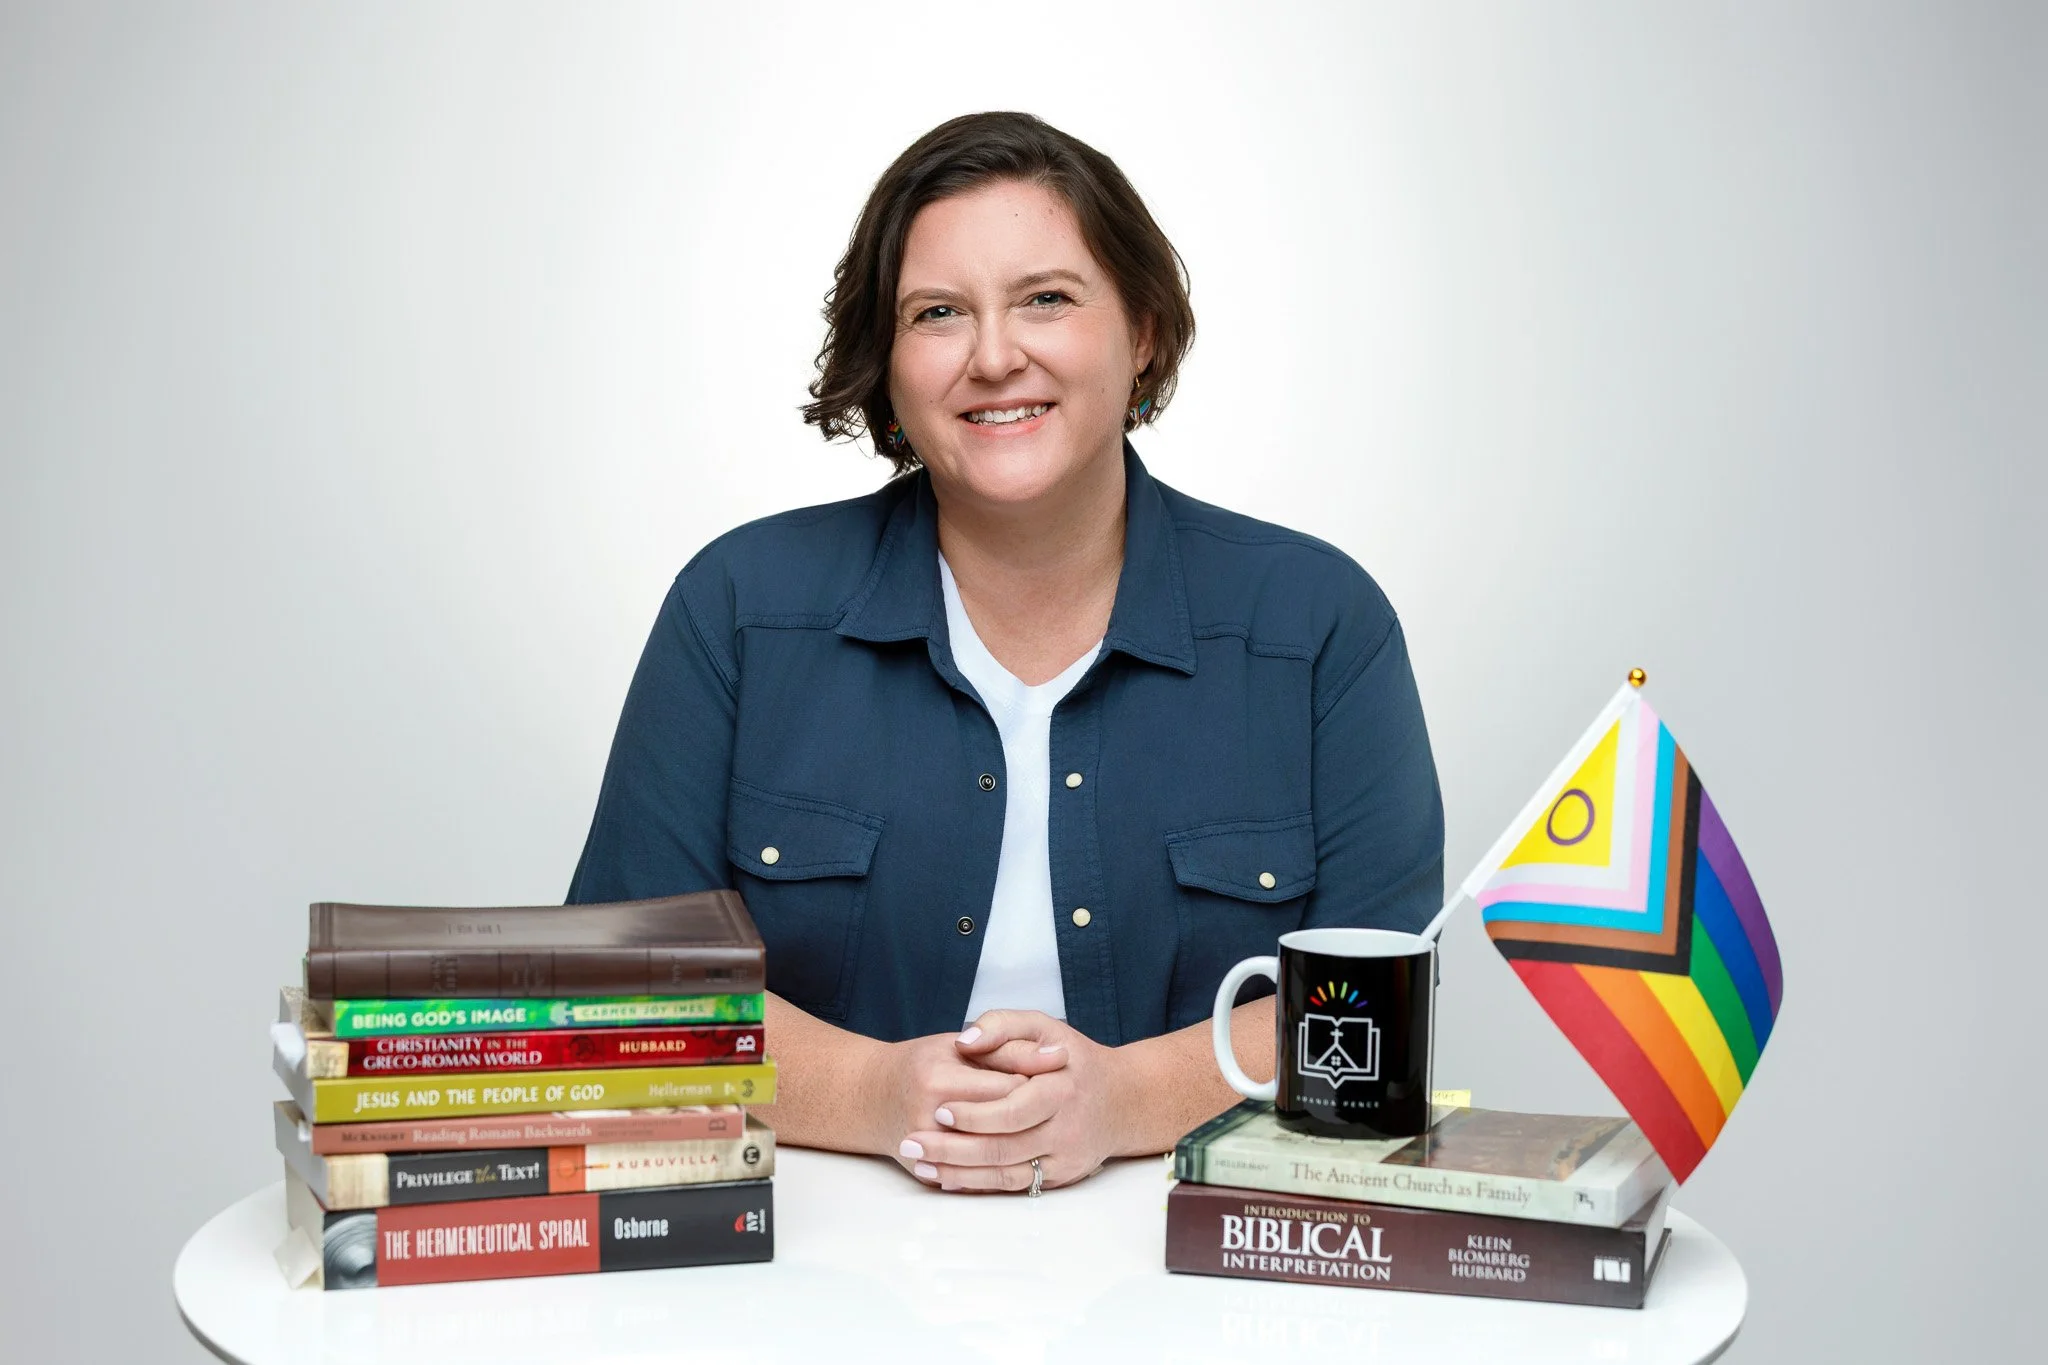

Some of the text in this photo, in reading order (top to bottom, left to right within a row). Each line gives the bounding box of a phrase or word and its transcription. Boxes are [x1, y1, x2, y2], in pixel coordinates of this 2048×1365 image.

[352, 1008, 526, 1029] BEING GOD'S IMAGE
[582, 1008, 636, 1017] CARMEN
[643, 1006, 667, 1015] JOY
[377, 1037, 528, 1053] CHRISTIANITY IN THE
[619, 1040, 686, 1053] HUBBARD
[363, 1051, 542, 1070] GRECO-ROMAN WORLD
[354, 1084, 605, 1113] JESUS AND THE PEOPLE OF GOD
[649, 1082, 713, 1097] Hellerman
[412, 1128, 466, 1144] Reading
[468, 1126, 521, 1141] Romans
[524, 1122, 592, 1138] Backwards
[616, 1154, 720, 1169] KURUVILLA
[1290, 1162, 1532, 1209] The Ancient Church as Family
[1244, 1204, 1371, 1226] INTRODUCTION TO
[614, 1216, 669, 1240] Osborne
[384, 1218, 590, 1260] THE HERMENEUTICAL SPIRAL
[1220, 1214, 1393, 1264] BIBLICAL
[1467, 1234, 1512, 1251] KLEIN
[1222, 1252, 1391, 1282] INTERPRETATION
[1448, 1248, 1530, 1269] BLOMBERG
[1451, 1263, 1526, 1283] HUBBARD
